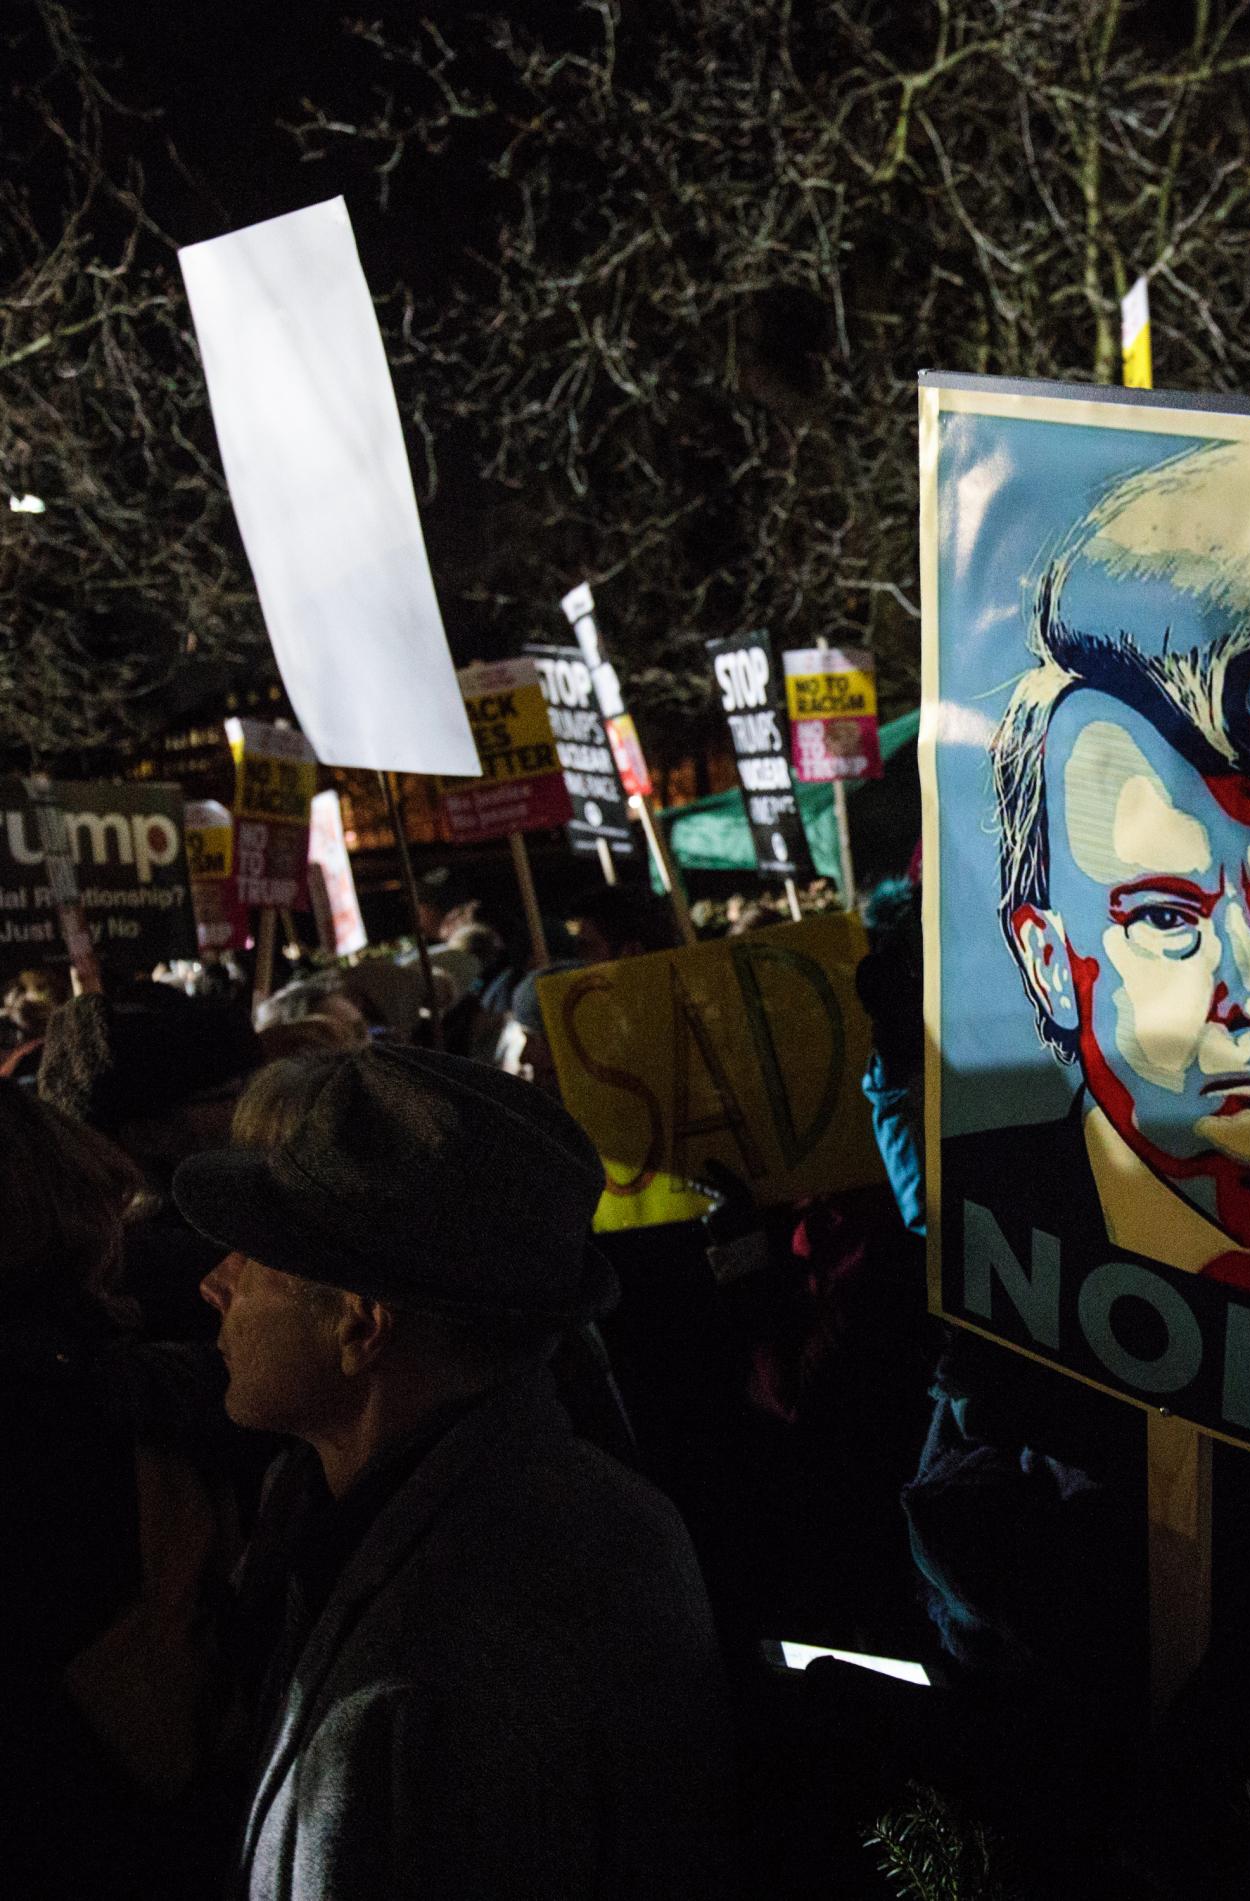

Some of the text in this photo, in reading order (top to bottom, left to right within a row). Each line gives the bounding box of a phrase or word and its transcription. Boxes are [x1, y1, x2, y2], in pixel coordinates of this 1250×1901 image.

[714, 647, 769, 712] STOP
[0, 811, 180, 884] ump
[562, 941, 845, 1196] SAD
